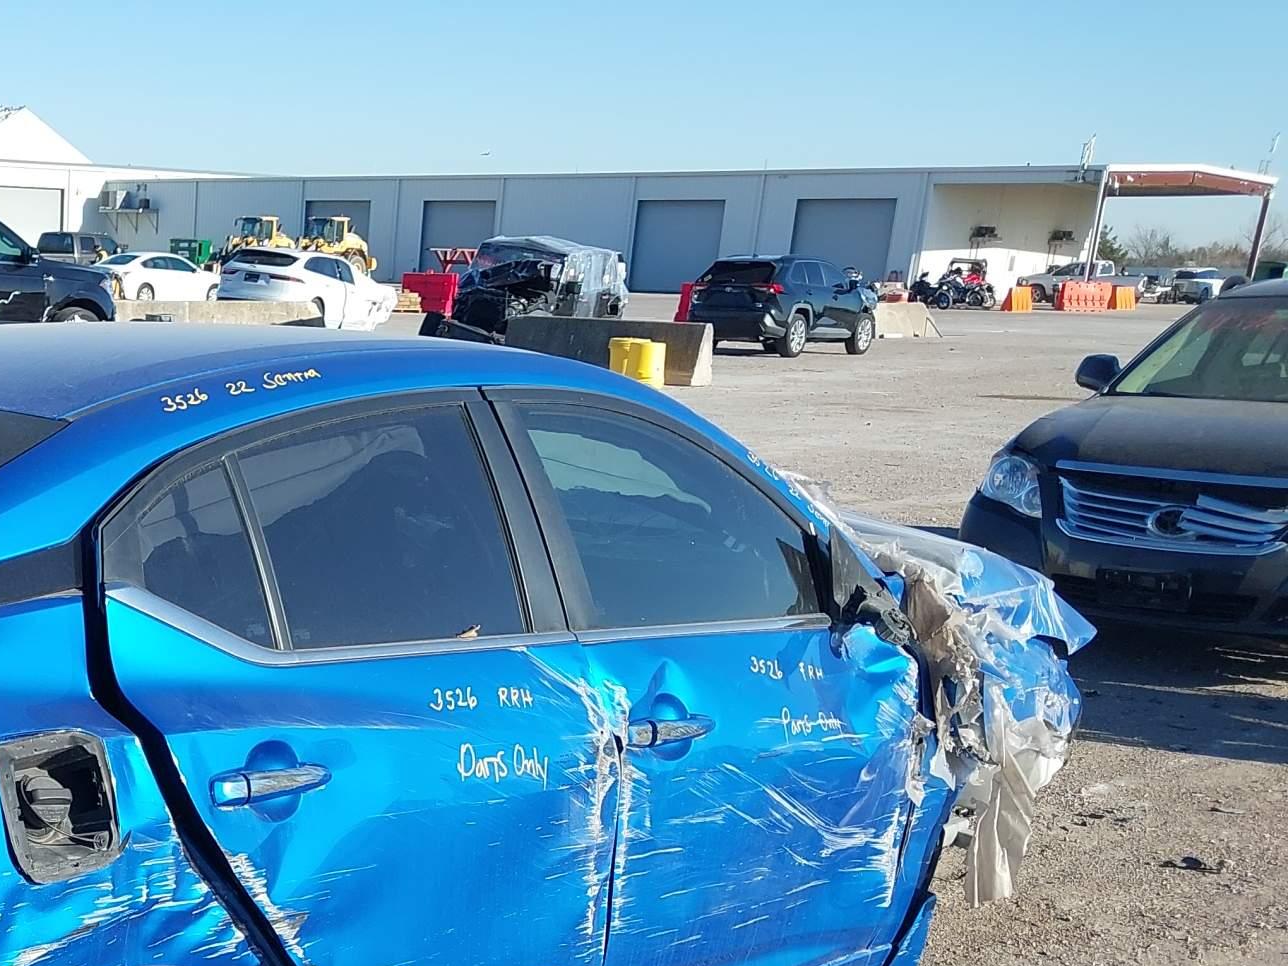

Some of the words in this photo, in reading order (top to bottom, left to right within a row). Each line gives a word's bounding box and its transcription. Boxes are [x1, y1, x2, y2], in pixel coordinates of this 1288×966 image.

[160, 388, 209, 413] 3526
[225, 380, 255, 396] 22
[749, 655, 783, 680] 3526
[429, 686, 478, 712] 3526
[497, 686, 534, 709] RRH
[513, 742, 549, 791] Only
